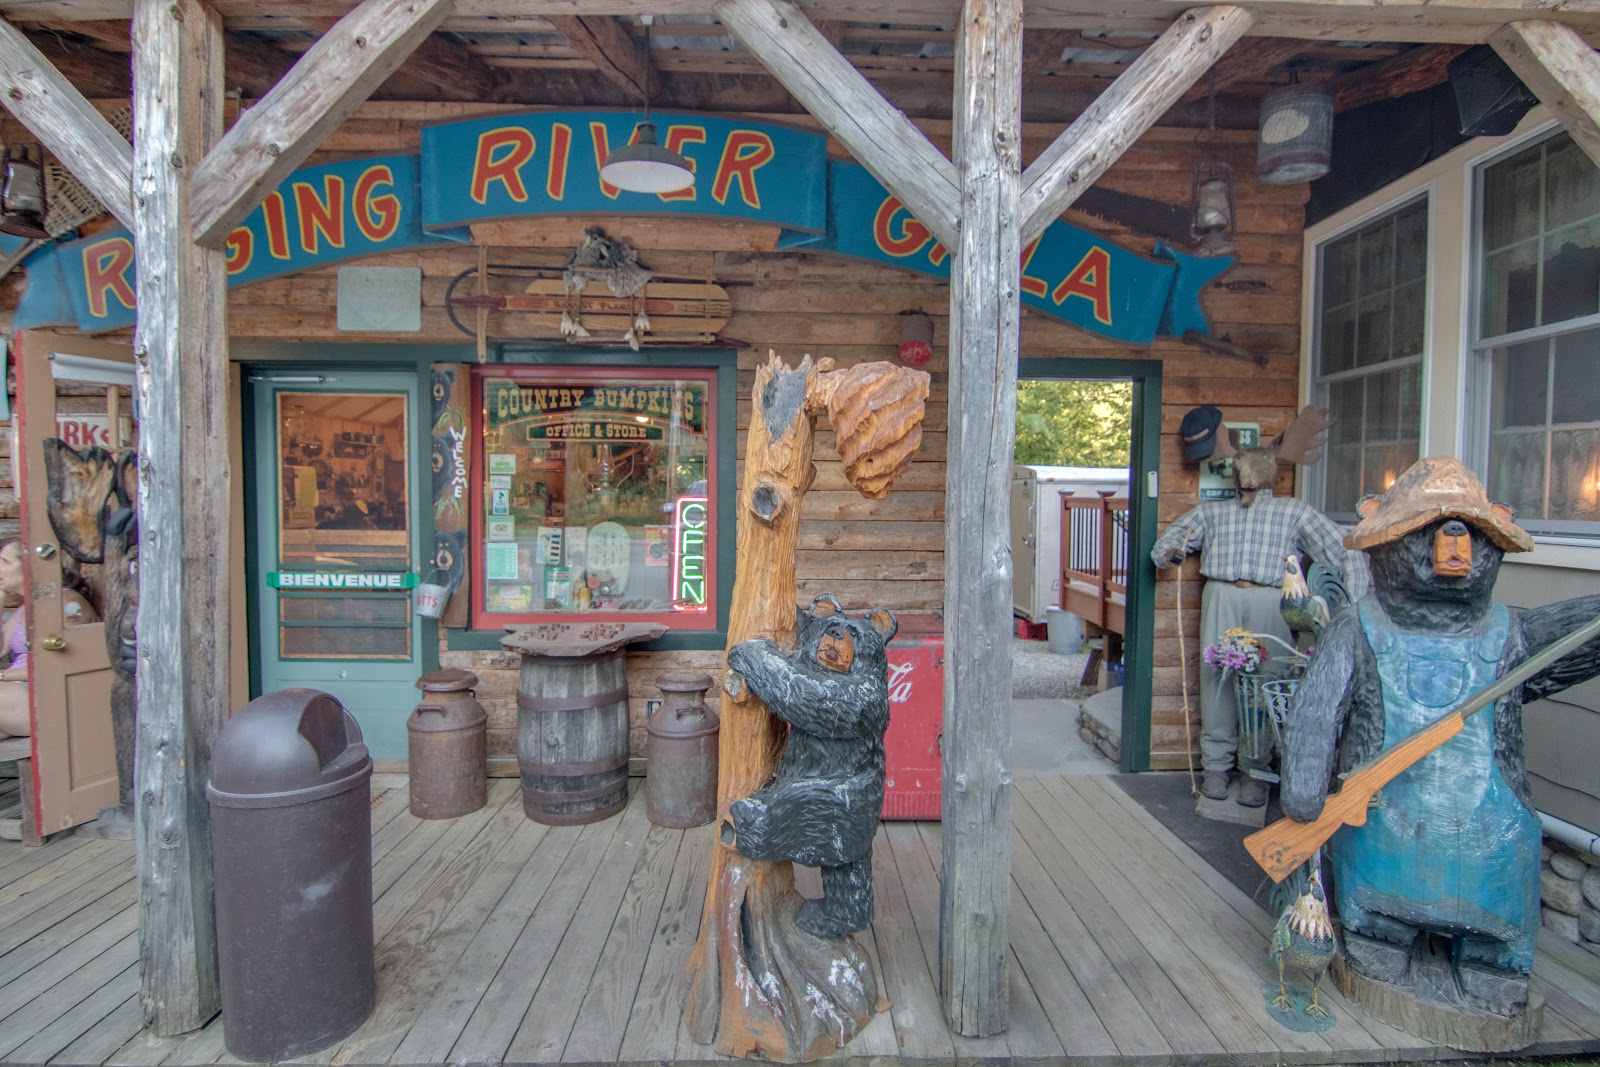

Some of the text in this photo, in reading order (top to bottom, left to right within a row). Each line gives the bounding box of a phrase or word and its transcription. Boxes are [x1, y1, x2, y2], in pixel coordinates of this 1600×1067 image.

[874, 195, 1113, 326] GLA
[498, 388, 694, 420] COUNTRY BUMPKINS
[546, 423, 647, 437] OFFICE & STORE
[449, 426, 467, 498] WELCOME
[279, 573, 401, 587] BIENVENUE
